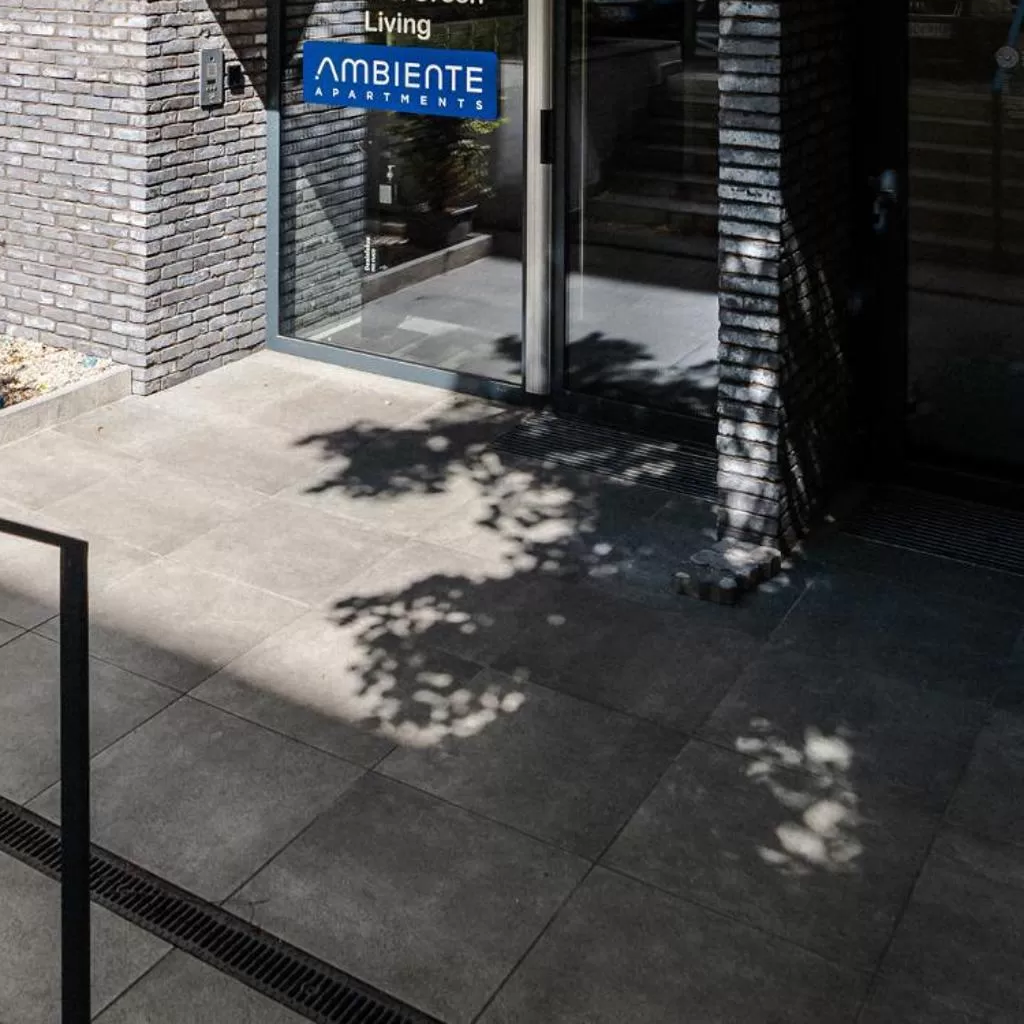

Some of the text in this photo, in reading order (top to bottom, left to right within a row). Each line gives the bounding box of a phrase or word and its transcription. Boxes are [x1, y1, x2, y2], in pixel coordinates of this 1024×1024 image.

[364, 10, 431, 40] Living
[314, 56, 483, 94] AMBIENTE
[314, 87, 483, 111] APARTMENTS
